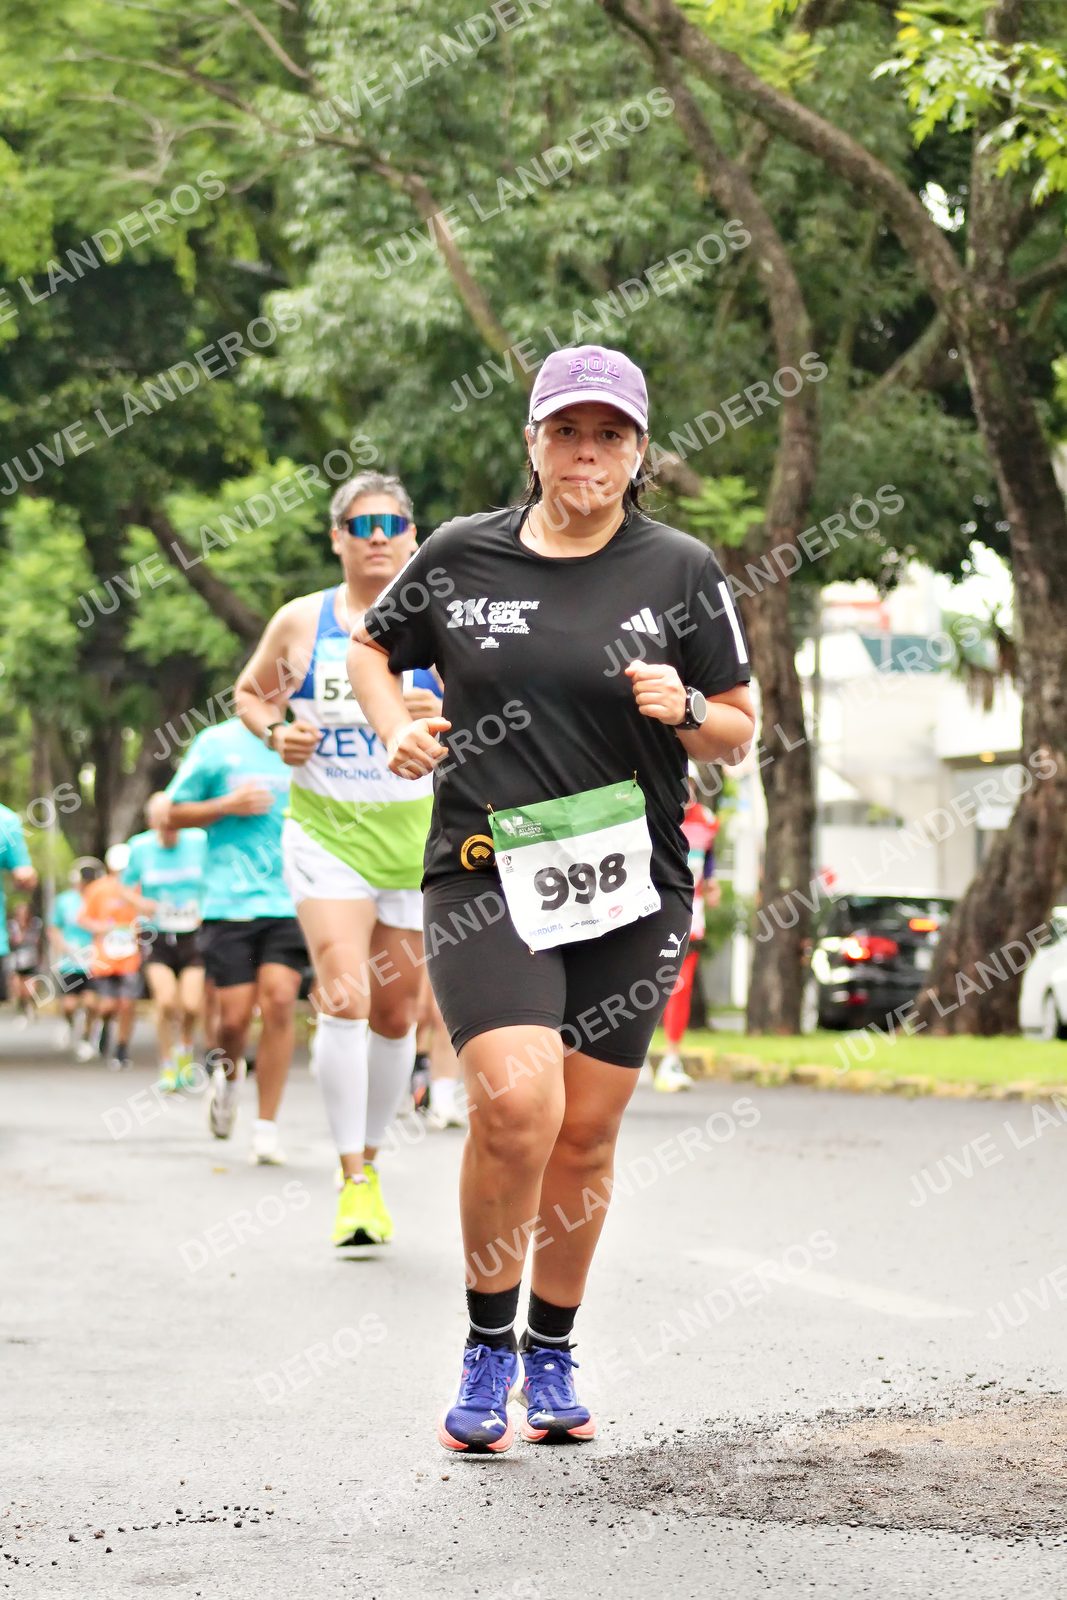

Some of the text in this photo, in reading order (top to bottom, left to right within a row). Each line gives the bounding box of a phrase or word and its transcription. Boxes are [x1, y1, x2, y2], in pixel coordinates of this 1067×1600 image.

[568, 352, 620, 379] BOL
[488, 600, 540, 611] COMUDE
[487, 609, 526, 625] GDL
[489, 624, 530, 635] Electrolit
[533, 852, 627, 911] 998
